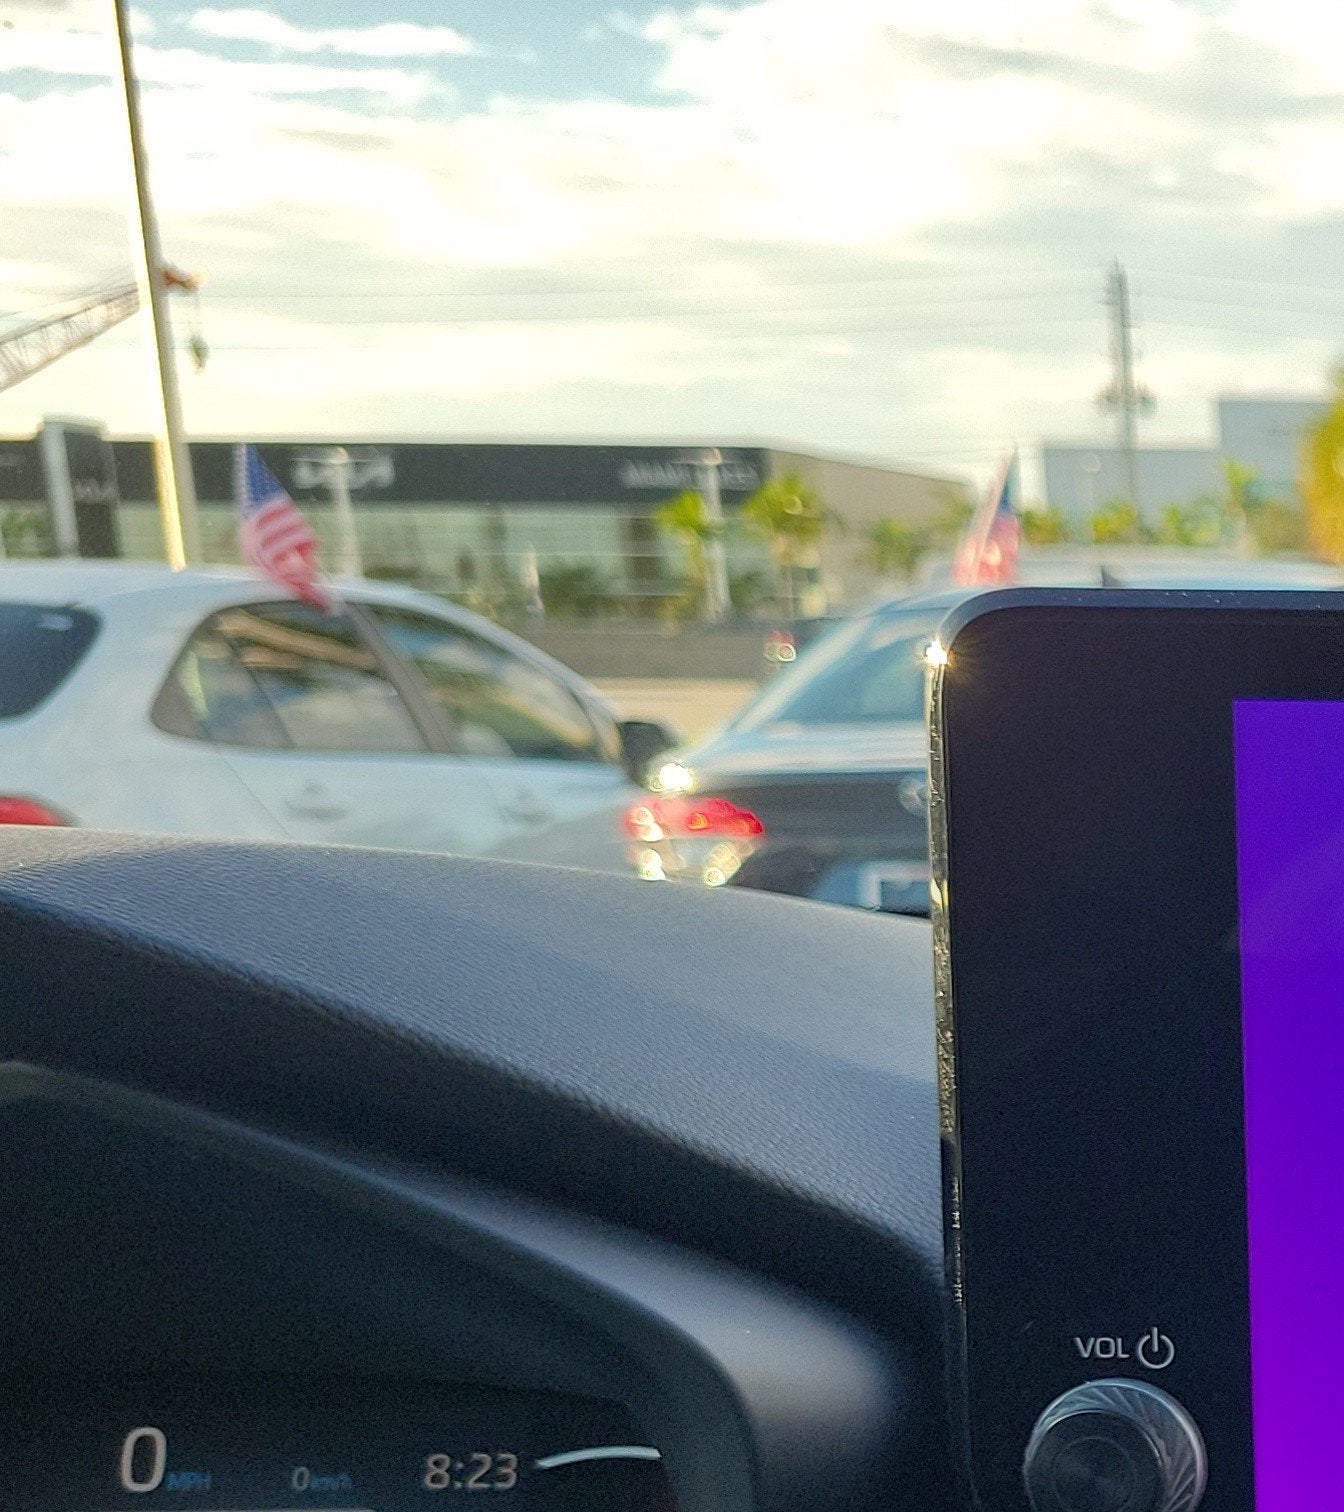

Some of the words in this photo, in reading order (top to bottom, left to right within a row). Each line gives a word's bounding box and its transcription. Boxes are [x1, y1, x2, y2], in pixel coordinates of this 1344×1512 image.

[1074, 1336, 1130, 1359] VOL
[120, 1426, 167, 1493] 0
[422, 1452, 518, 1490] 8:23
[291, 1466, 310, 1491] 0
